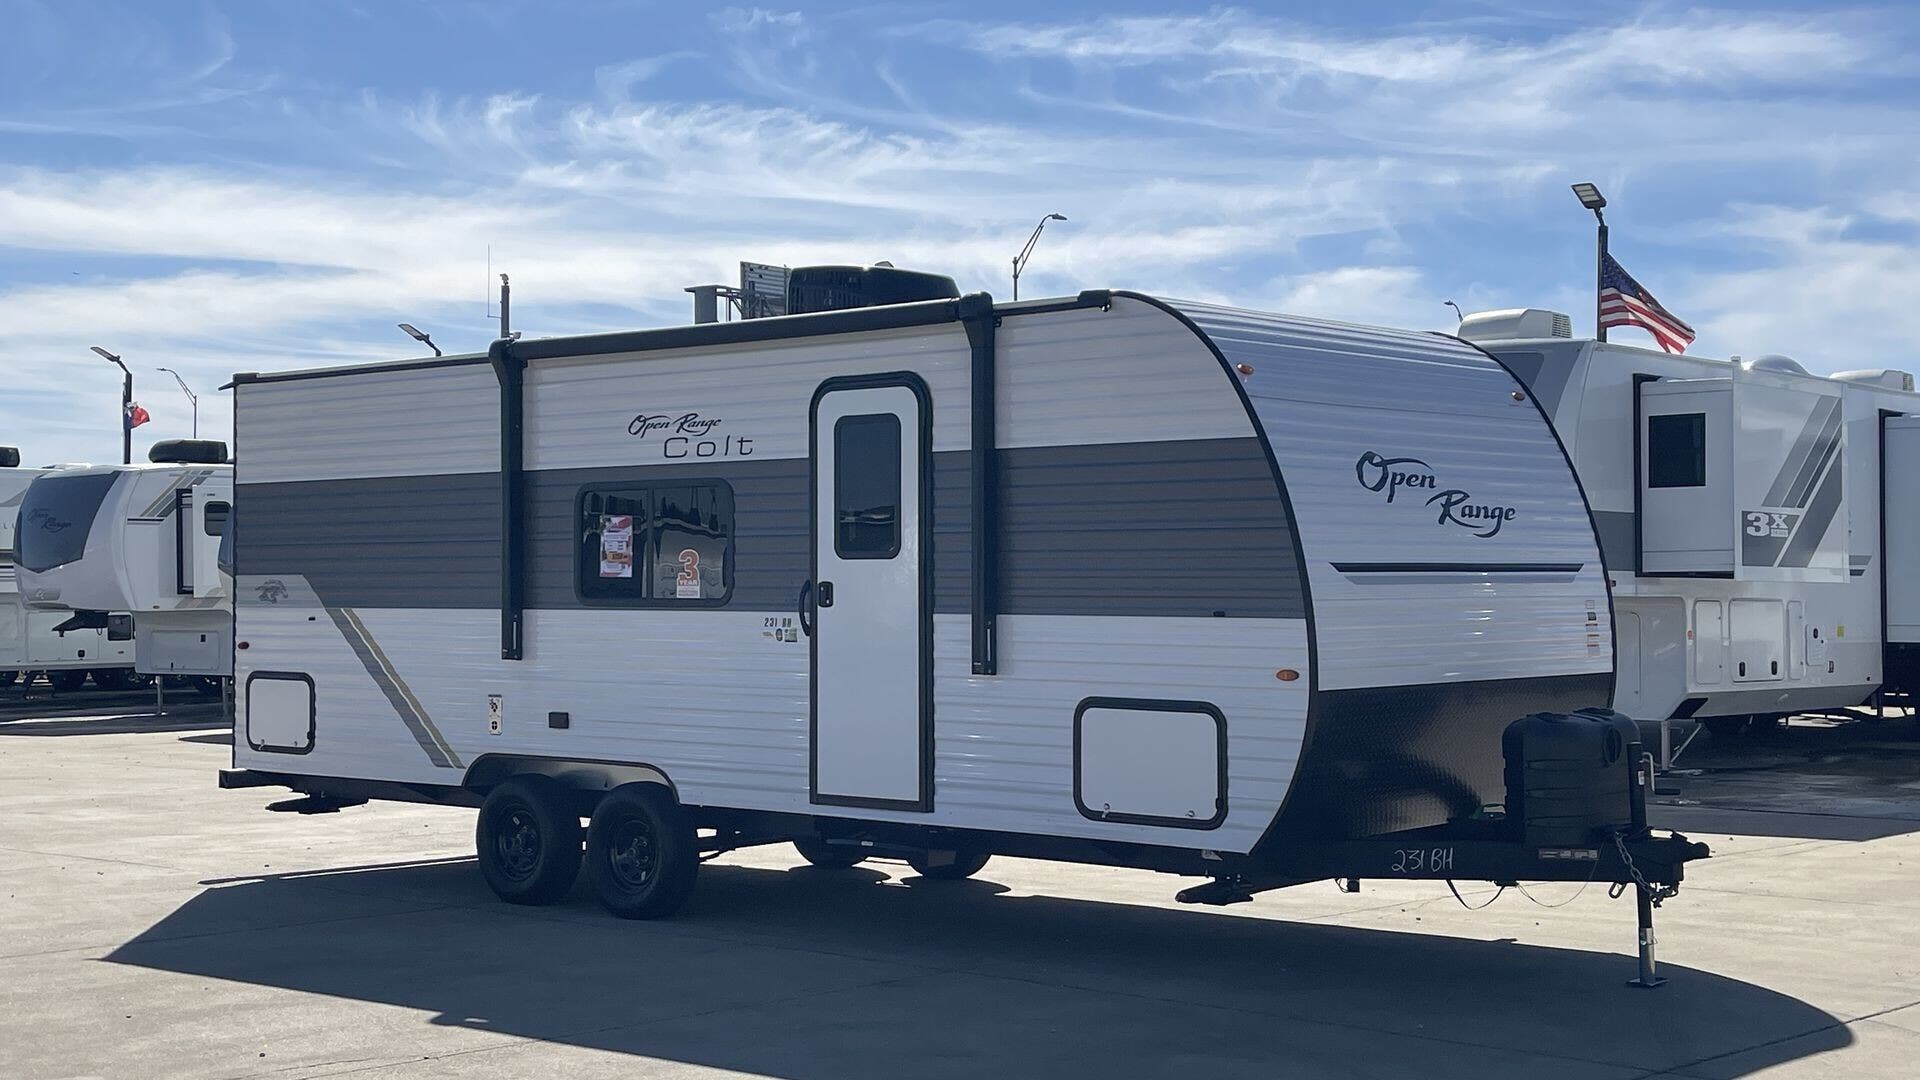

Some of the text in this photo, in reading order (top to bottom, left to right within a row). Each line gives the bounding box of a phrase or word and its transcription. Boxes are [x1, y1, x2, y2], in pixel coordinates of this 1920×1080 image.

[628, 413, 722, 438] Open Range
[664, 435, 753, 458] Colt
[1356, 451, 1436, 503] Open
[1425, 490, 1517, 538] Range
[678, 549, 700, 580] 3
[764, 617, 778, 627] 231
[1391, 848, 1454, 873] 231 BH
